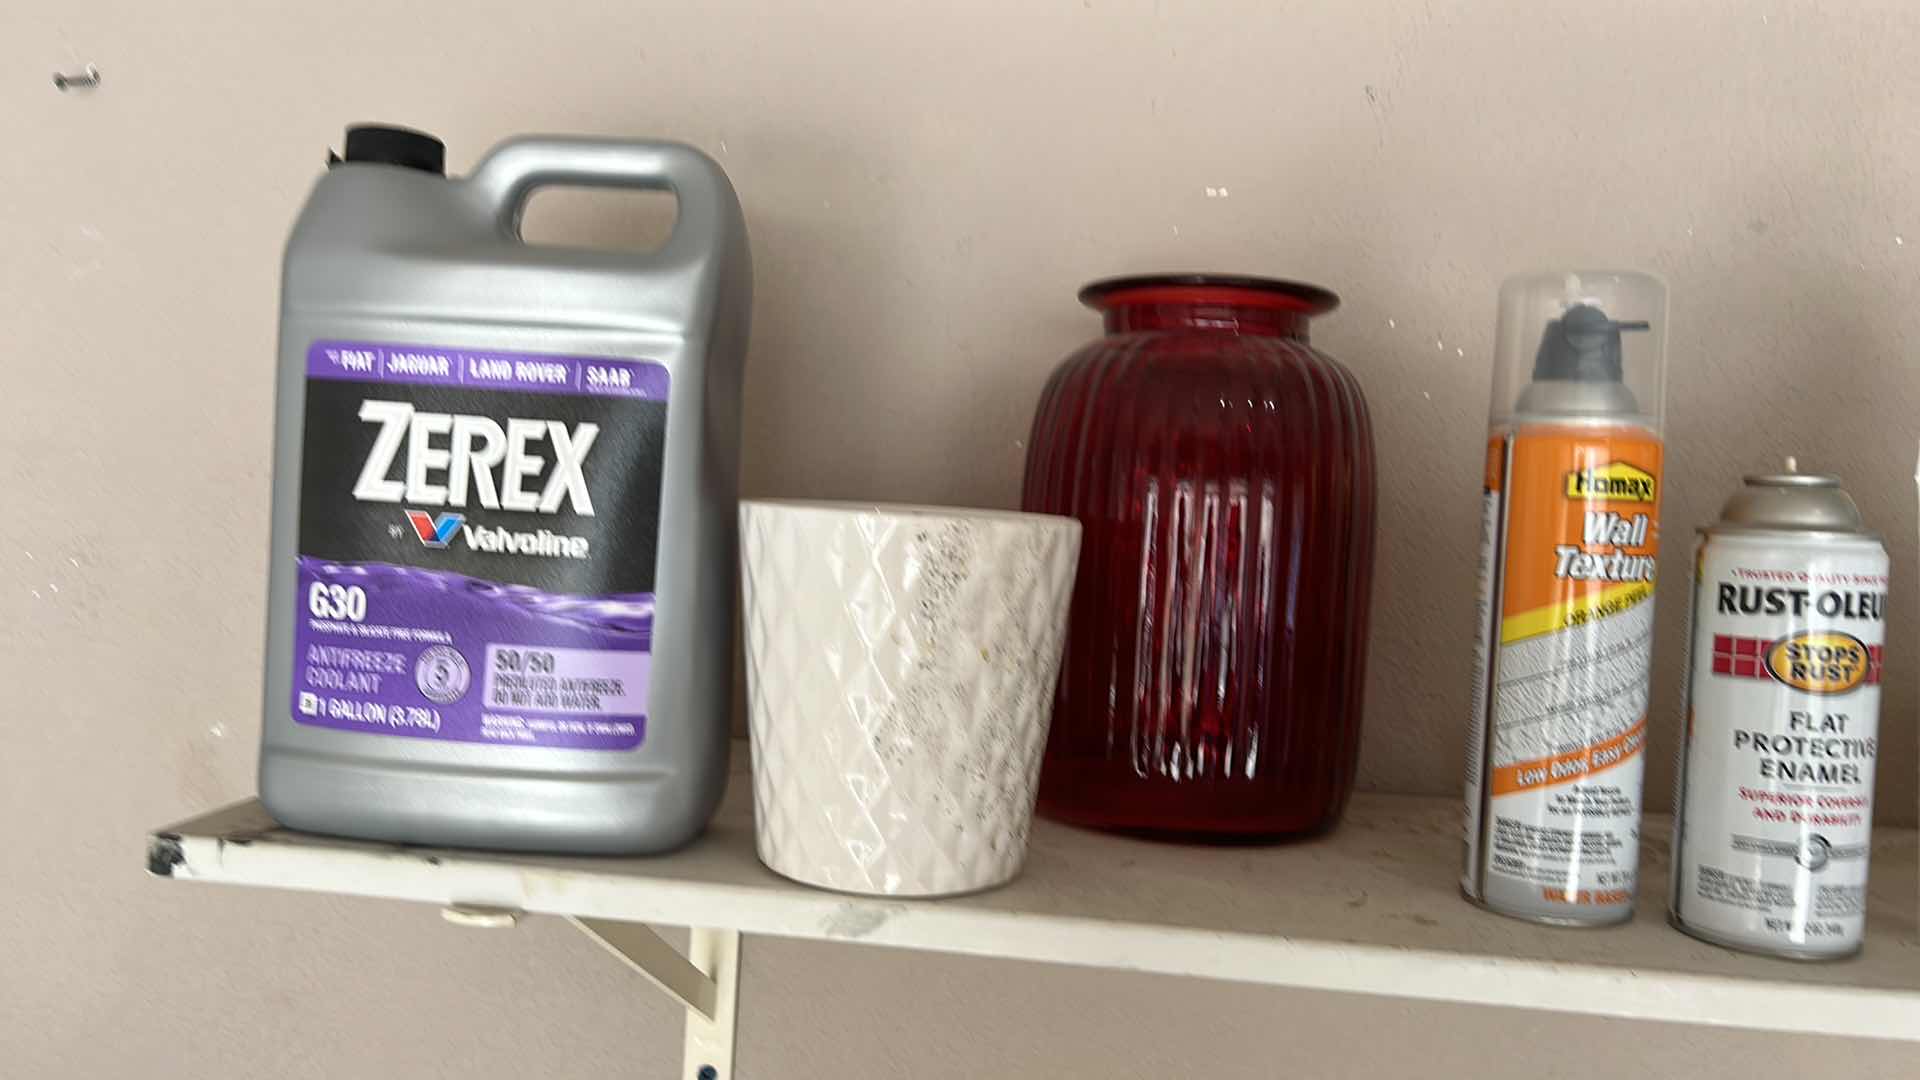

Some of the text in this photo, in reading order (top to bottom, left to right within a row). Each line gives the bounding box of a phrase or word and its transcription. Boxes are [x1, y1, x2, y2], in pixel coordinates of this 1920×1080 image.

[387, 353, 449, 376] JAGUAR
[469, 358, 512, 380] LAND
[515, 361, 567, 384] ROVER
[352, 399, 599, 517] ZEREX
[1575, 472, 1651, 499] Homax
[463, 524, 591, 558] Valvoline
[1583, 511, 1648, 546] Wall
[1795, 571, 1850, 585] QALITY
[306, 645, 407, 675] ANTIFREEZE
[495, 649, 555, 673] 50/50
[1785, 641, 1861, 664] STOPS
[305, 665, 382, 694] COOLANT
[1789, 661, 1853, 683] RUST
[494, 687, 509, 705] DO
[511, 688, 531, 707] NOT
[536, 690, 558, 708] ADD
[319, 698, 326, 716] 1
[328, 697, 387, 724] GALLON
[1789, 710, 1850, 733] FLAT
[1517, 767, 1548, 786] Low
[1759, 758, 1861, 784] ENAMEL
[1738, 786, 1813, 807] SUPERIOR
[1753, 806, 1786, 823] AND
